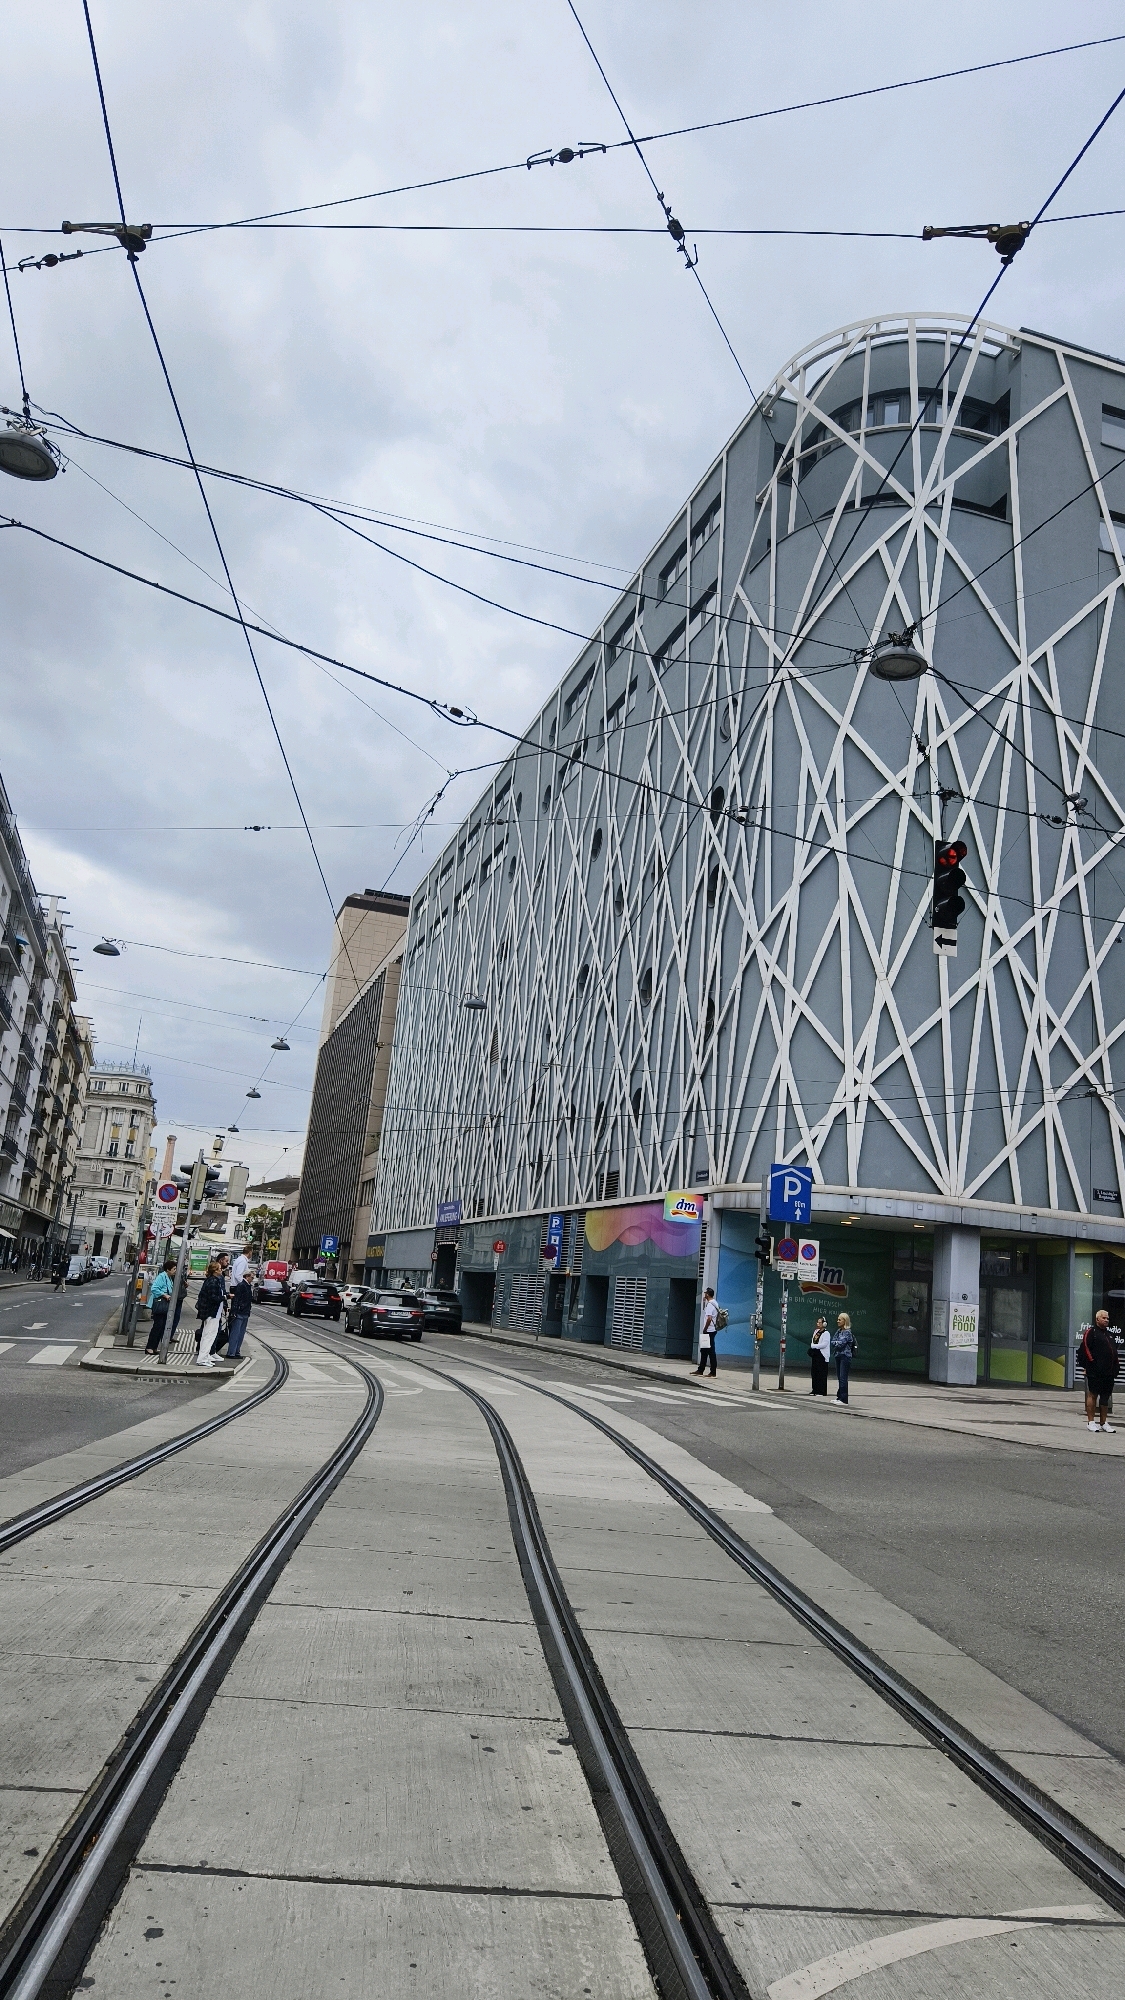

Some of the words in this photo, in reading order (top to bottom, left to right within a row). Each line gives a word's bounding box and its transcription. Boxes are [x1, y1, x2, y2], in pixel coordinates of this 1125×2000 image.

[783, 1175, 802, 1203] P
[675, 1198, 696, 1212] dm
[552, 1218, 560, 1228] P
[325, 1239, 334, 1250] P
[953, 1314, 976, 1324] ASIAN
[952, 1321, 976, 1333] FOOD
